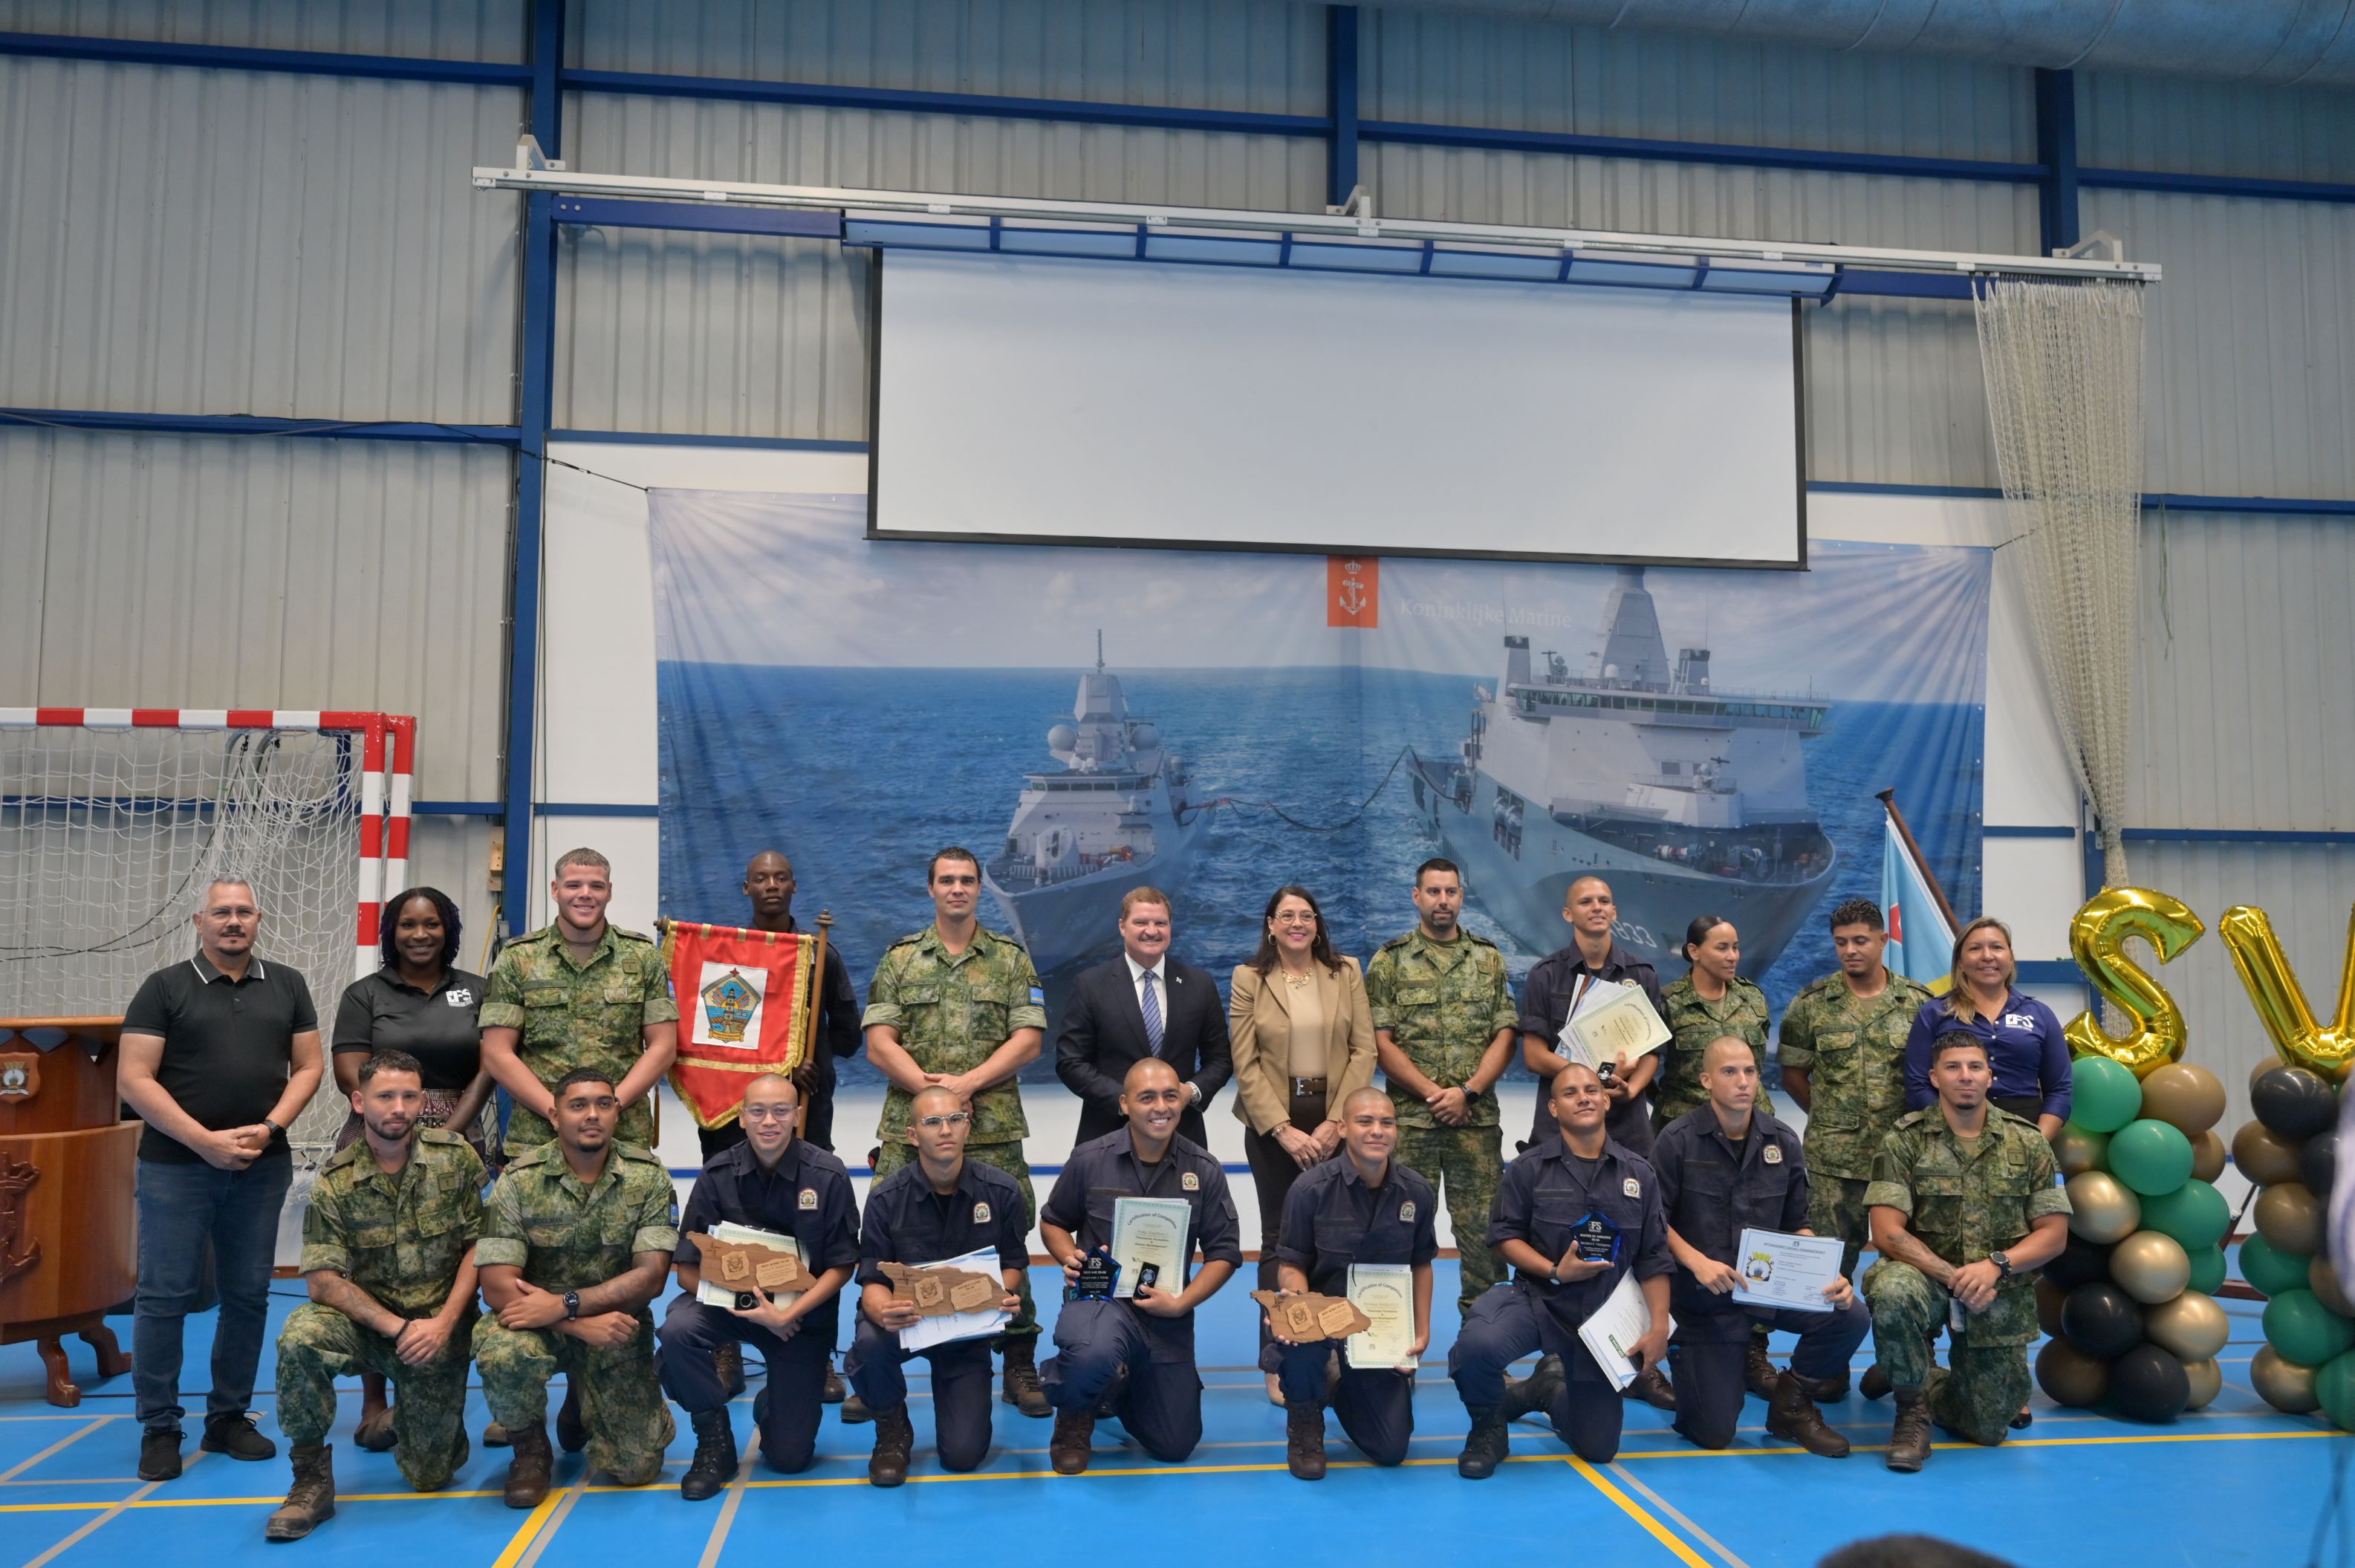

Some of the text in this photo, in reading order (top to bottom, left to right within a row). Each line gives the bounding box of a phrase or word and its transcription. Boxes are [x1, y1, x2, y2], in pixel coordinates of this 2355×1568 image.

[1400, 599, 1572, 628] Koninklijke Marine
[1609, 920, 1657, 949] 833
[1127, 1213, 1151, 1226] Certification
[1357, 1283, 1377, 1298] Certification
